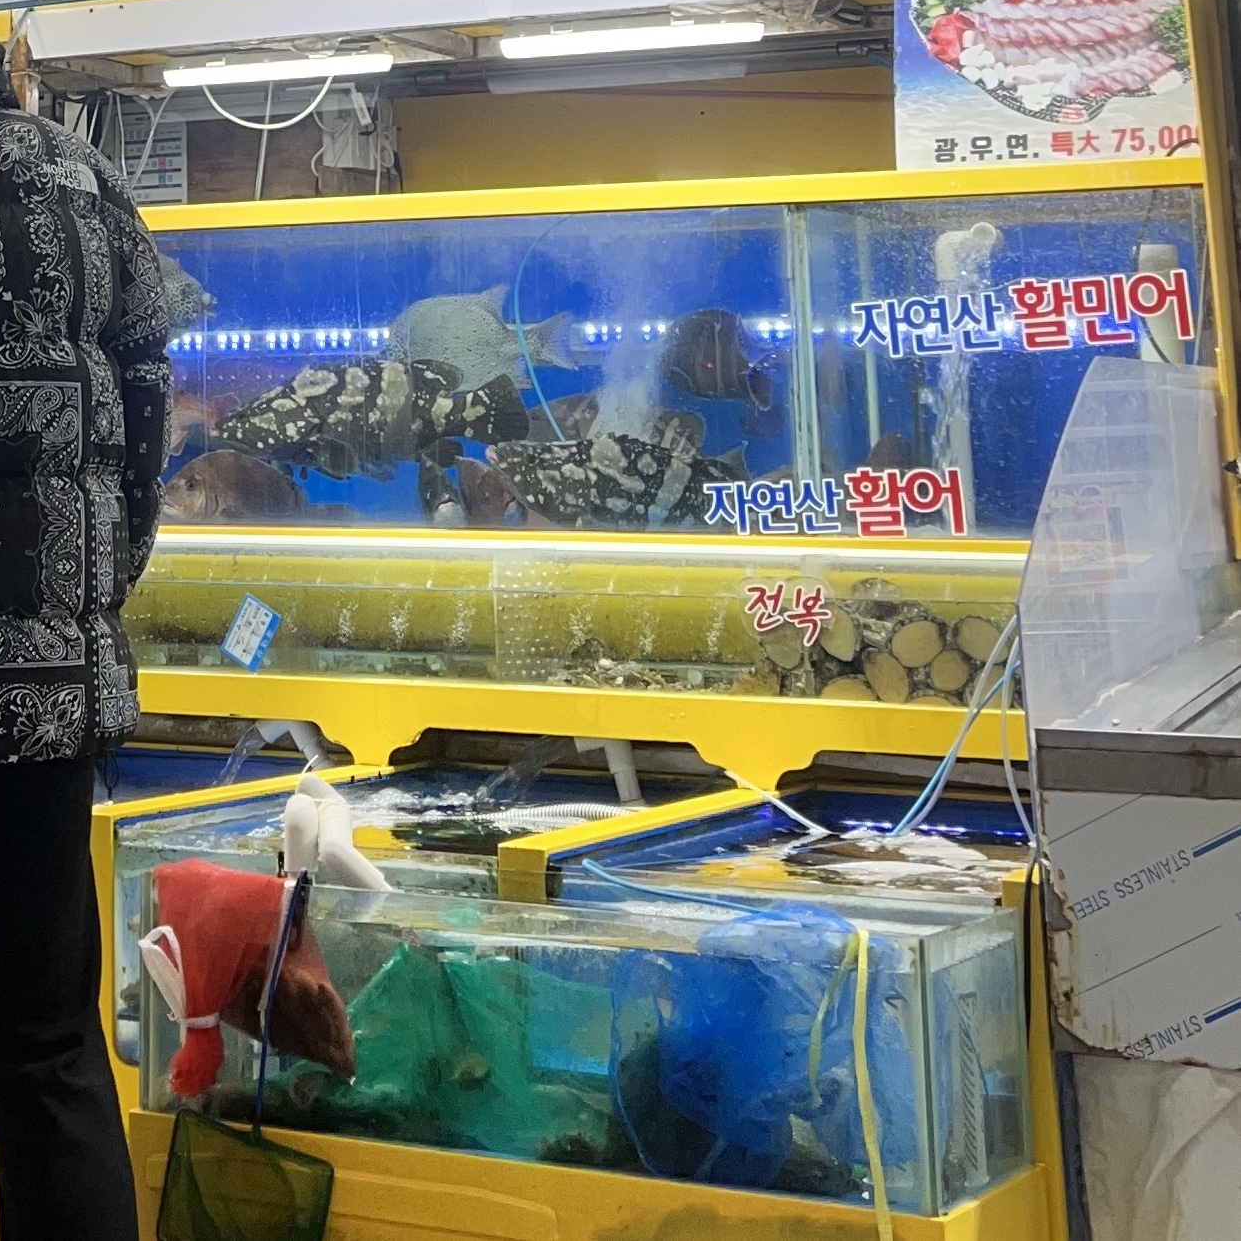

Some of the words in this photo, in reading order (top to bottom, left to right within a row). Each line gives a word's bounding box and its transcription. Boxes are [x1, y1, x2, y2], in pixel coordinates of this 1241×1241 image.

[41, 162, 79, 180] NORTH
[54, 157, 78, 169] THE
[55, 175, 81, 190] FACE
[853, 292, 1005, 357] 자연산
[1009, 269, 1195, 351] 활민어
[704, 478, 845, 535] 자연산
[846, 466, 968, 538] 활어
[744, 583, 833, 647] 전복
[1113, 849, 1192, 900] STAINLESS
